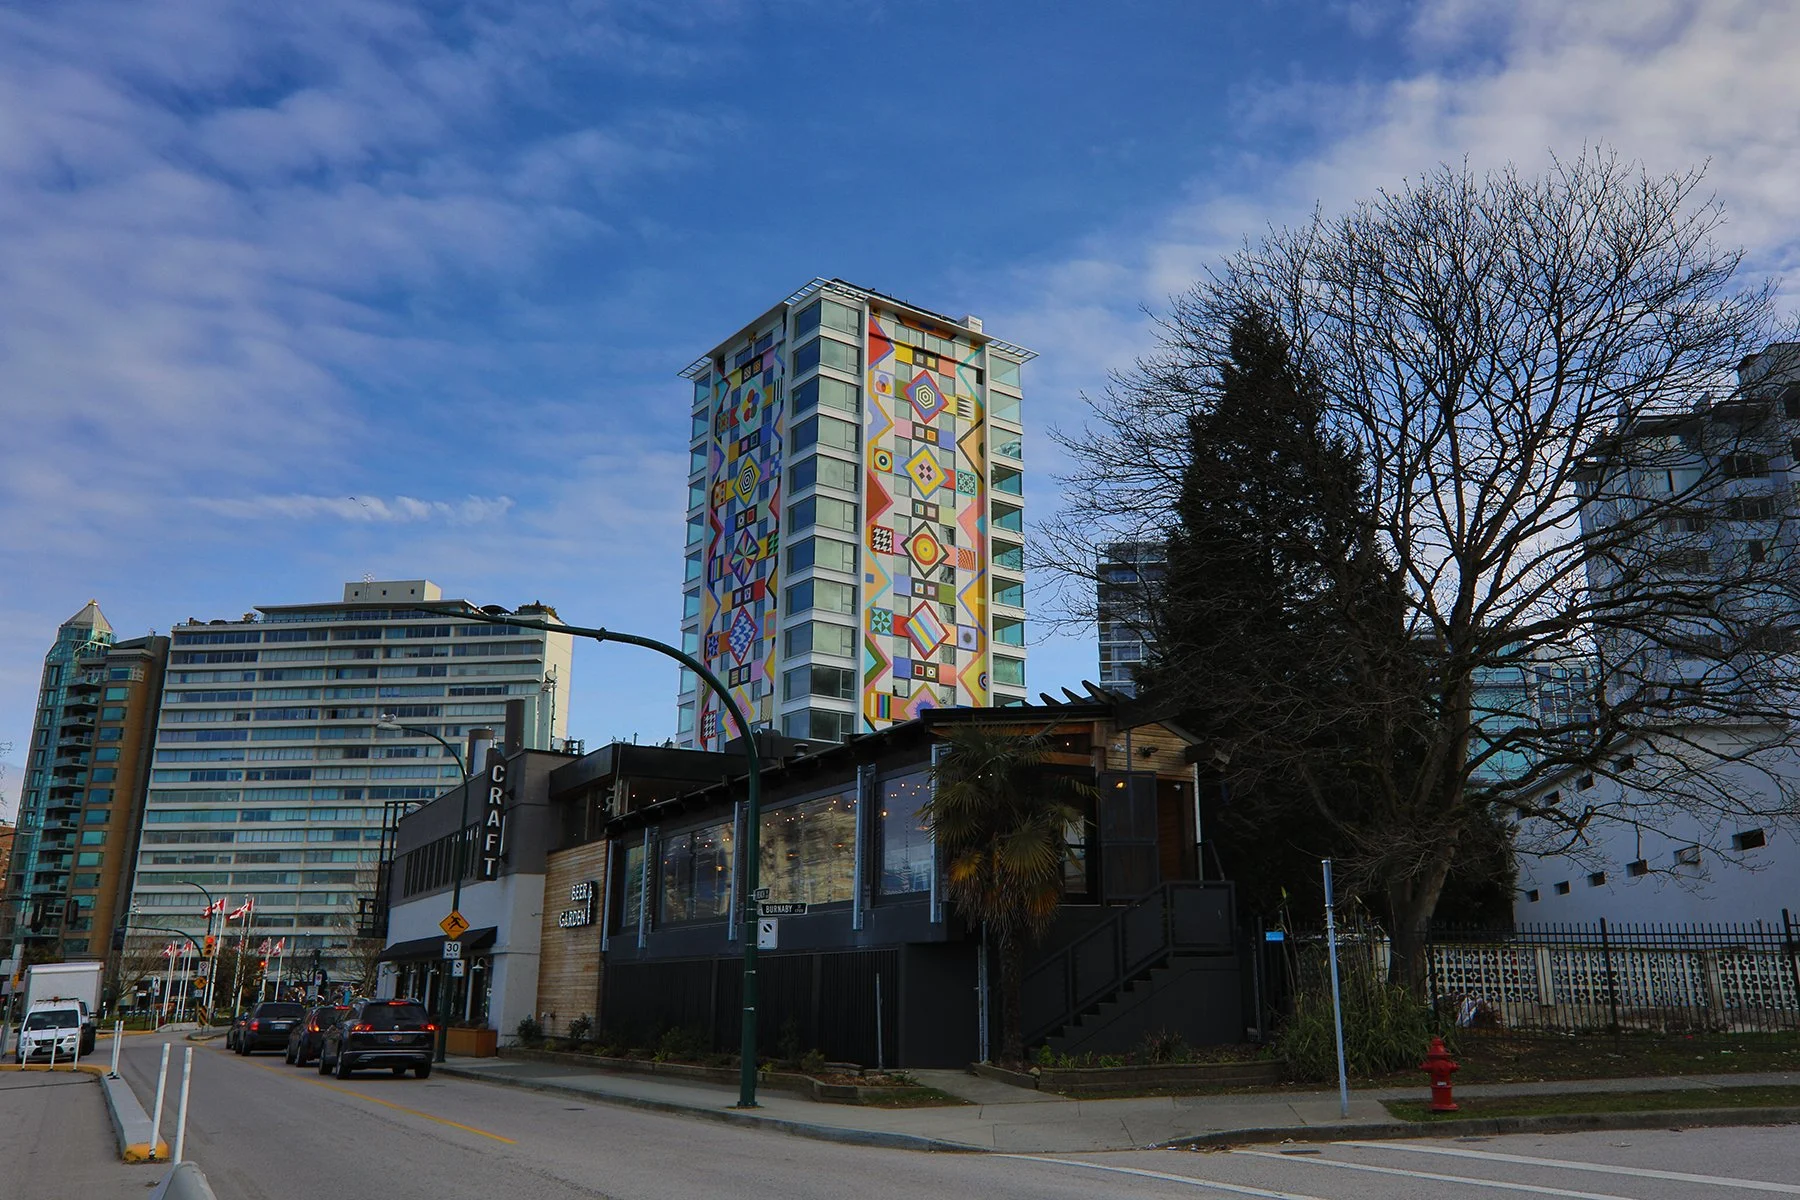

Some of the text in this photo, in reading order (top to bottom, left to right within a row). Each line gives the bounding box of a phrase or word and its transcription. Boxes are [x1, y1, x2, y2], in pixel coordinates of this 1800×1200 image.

[484, 765, 505, 876] CRAFT
[571, 882, 588, 901] BEER
[559, 908, 586, 928] GARDEN
[766, 904, 793, 914] BURNABY
[446, 943, 459, 952] 30
